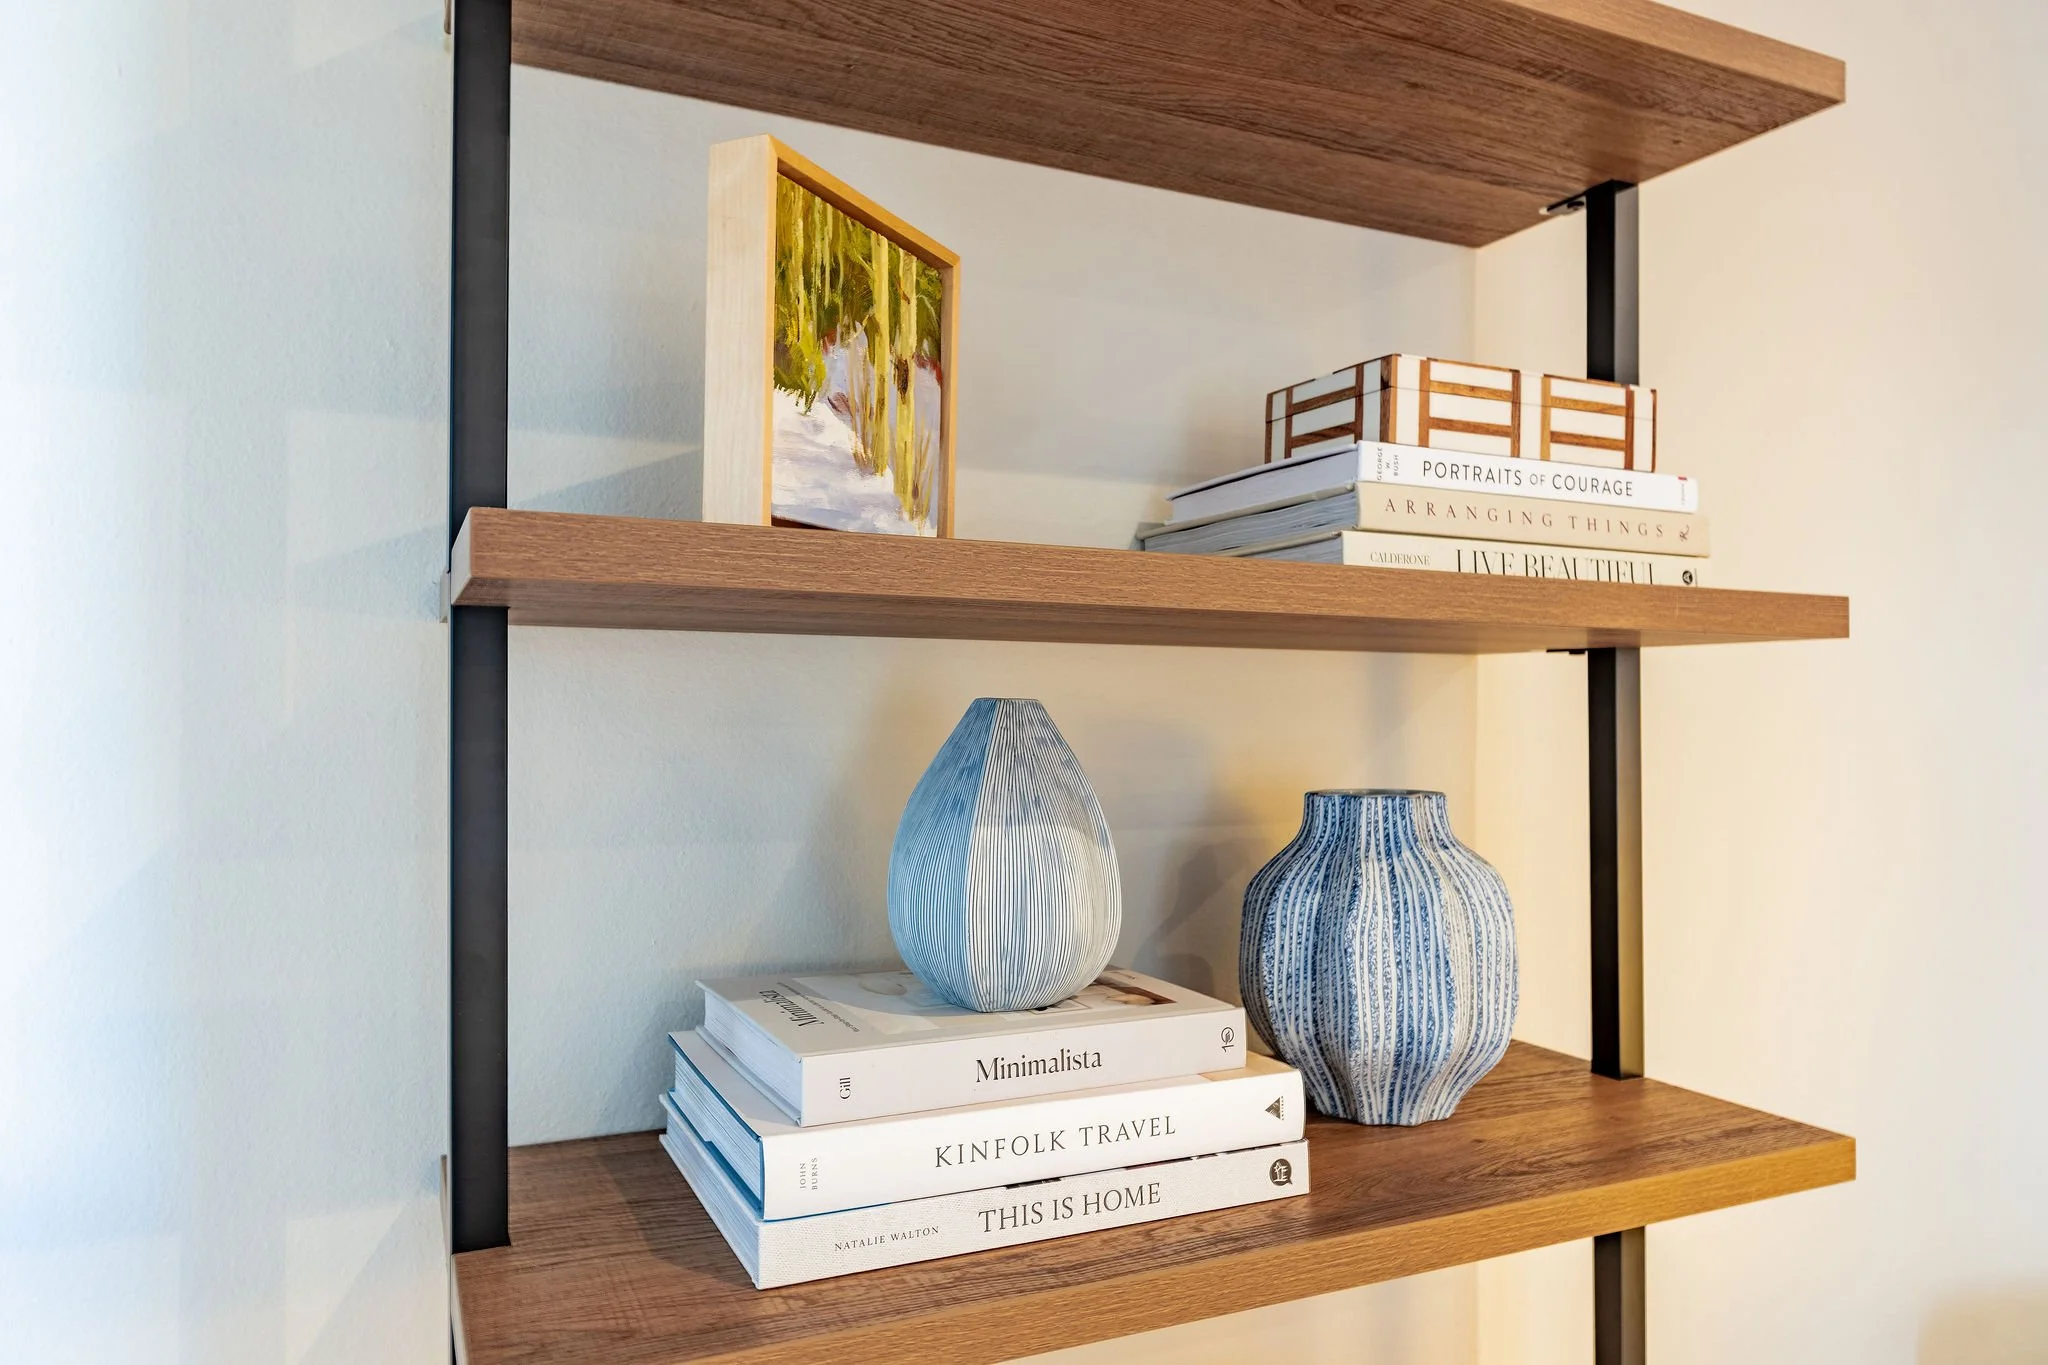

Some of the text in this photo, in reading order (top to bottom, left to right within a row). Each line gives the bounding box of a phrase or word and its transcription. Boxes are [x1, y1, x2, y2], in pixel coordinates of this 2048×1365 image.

[1423, 460, 1633, 497] PORTRAITS OF COURAGE
[1384, 498, 1663, 538] ARRANGING THINGS
[1370, 551, 1431, 567] CALDERONE
[975, 1048, 1103, 1083] Minimalista
[839, 1076, 851, 1100] Gill
[935, 1114, 1177, 1168] KINFOLK TRAVEL
[799, 1162, 807, 1189] JOHN
[978, 1181, 1162, 1233] THIS IS HOME
[834, 1225, 940, 1252] NATALIE WALTON
